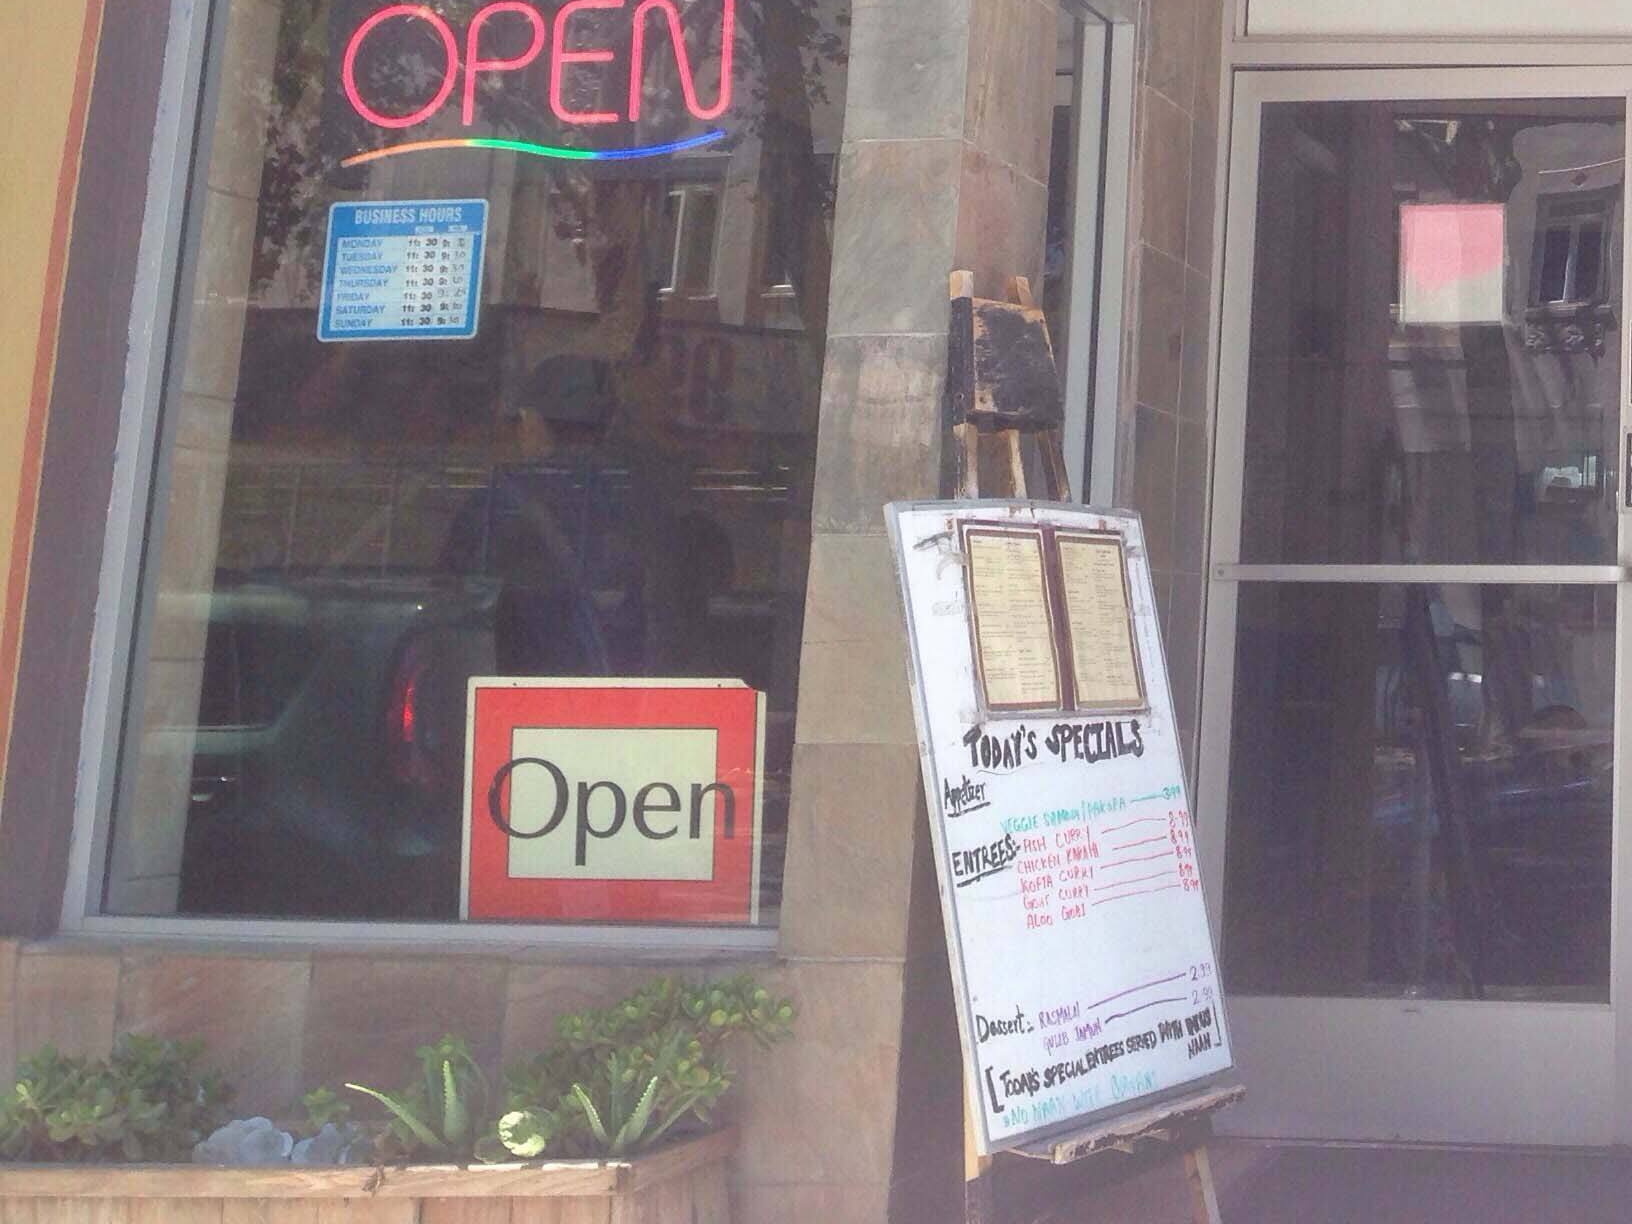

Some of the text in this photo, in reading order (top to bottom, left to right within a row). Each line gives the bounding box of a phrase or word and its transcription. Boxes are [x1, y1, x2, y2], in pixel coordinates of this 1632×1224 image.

[355, 207, 463, 225] BUSINESS HOURS
[341, 239, 383, 249] MONDAY
[341, 252, 383, 261] TUESDAY
[340, 264, 398, 274] WEDNESDAY
[338, 279, 388, 287] THURSDAY
[337, 293, 369, 301] FRIDAY
[336, 305, 385, 314] SATURDAY
[335, 319, 372, 327] SUNDAY
[963, 719, 1144, 768] TODAY'S SPECIALS
[488, 757, 735, 866] Open
[1000, 814, 1039, 834] VEGGIE
[1055, 826, 1091, 851] CURRY
[1017, 854, 1061, 874] CHICKEN
[1059, 865, 1094, 882] CURRY
[1058, 883, 1089, 900] CURRY
[1043, 1060, 1088, 1088] SPECIAL
[1085, 1041, 1125, 1070] ENTREES
[1126, 1030, 1157, 1054] SERVED
[1157, 1019, 1184, 1043] WITH
[1188, 1032, 1212, 1060] NAAN
